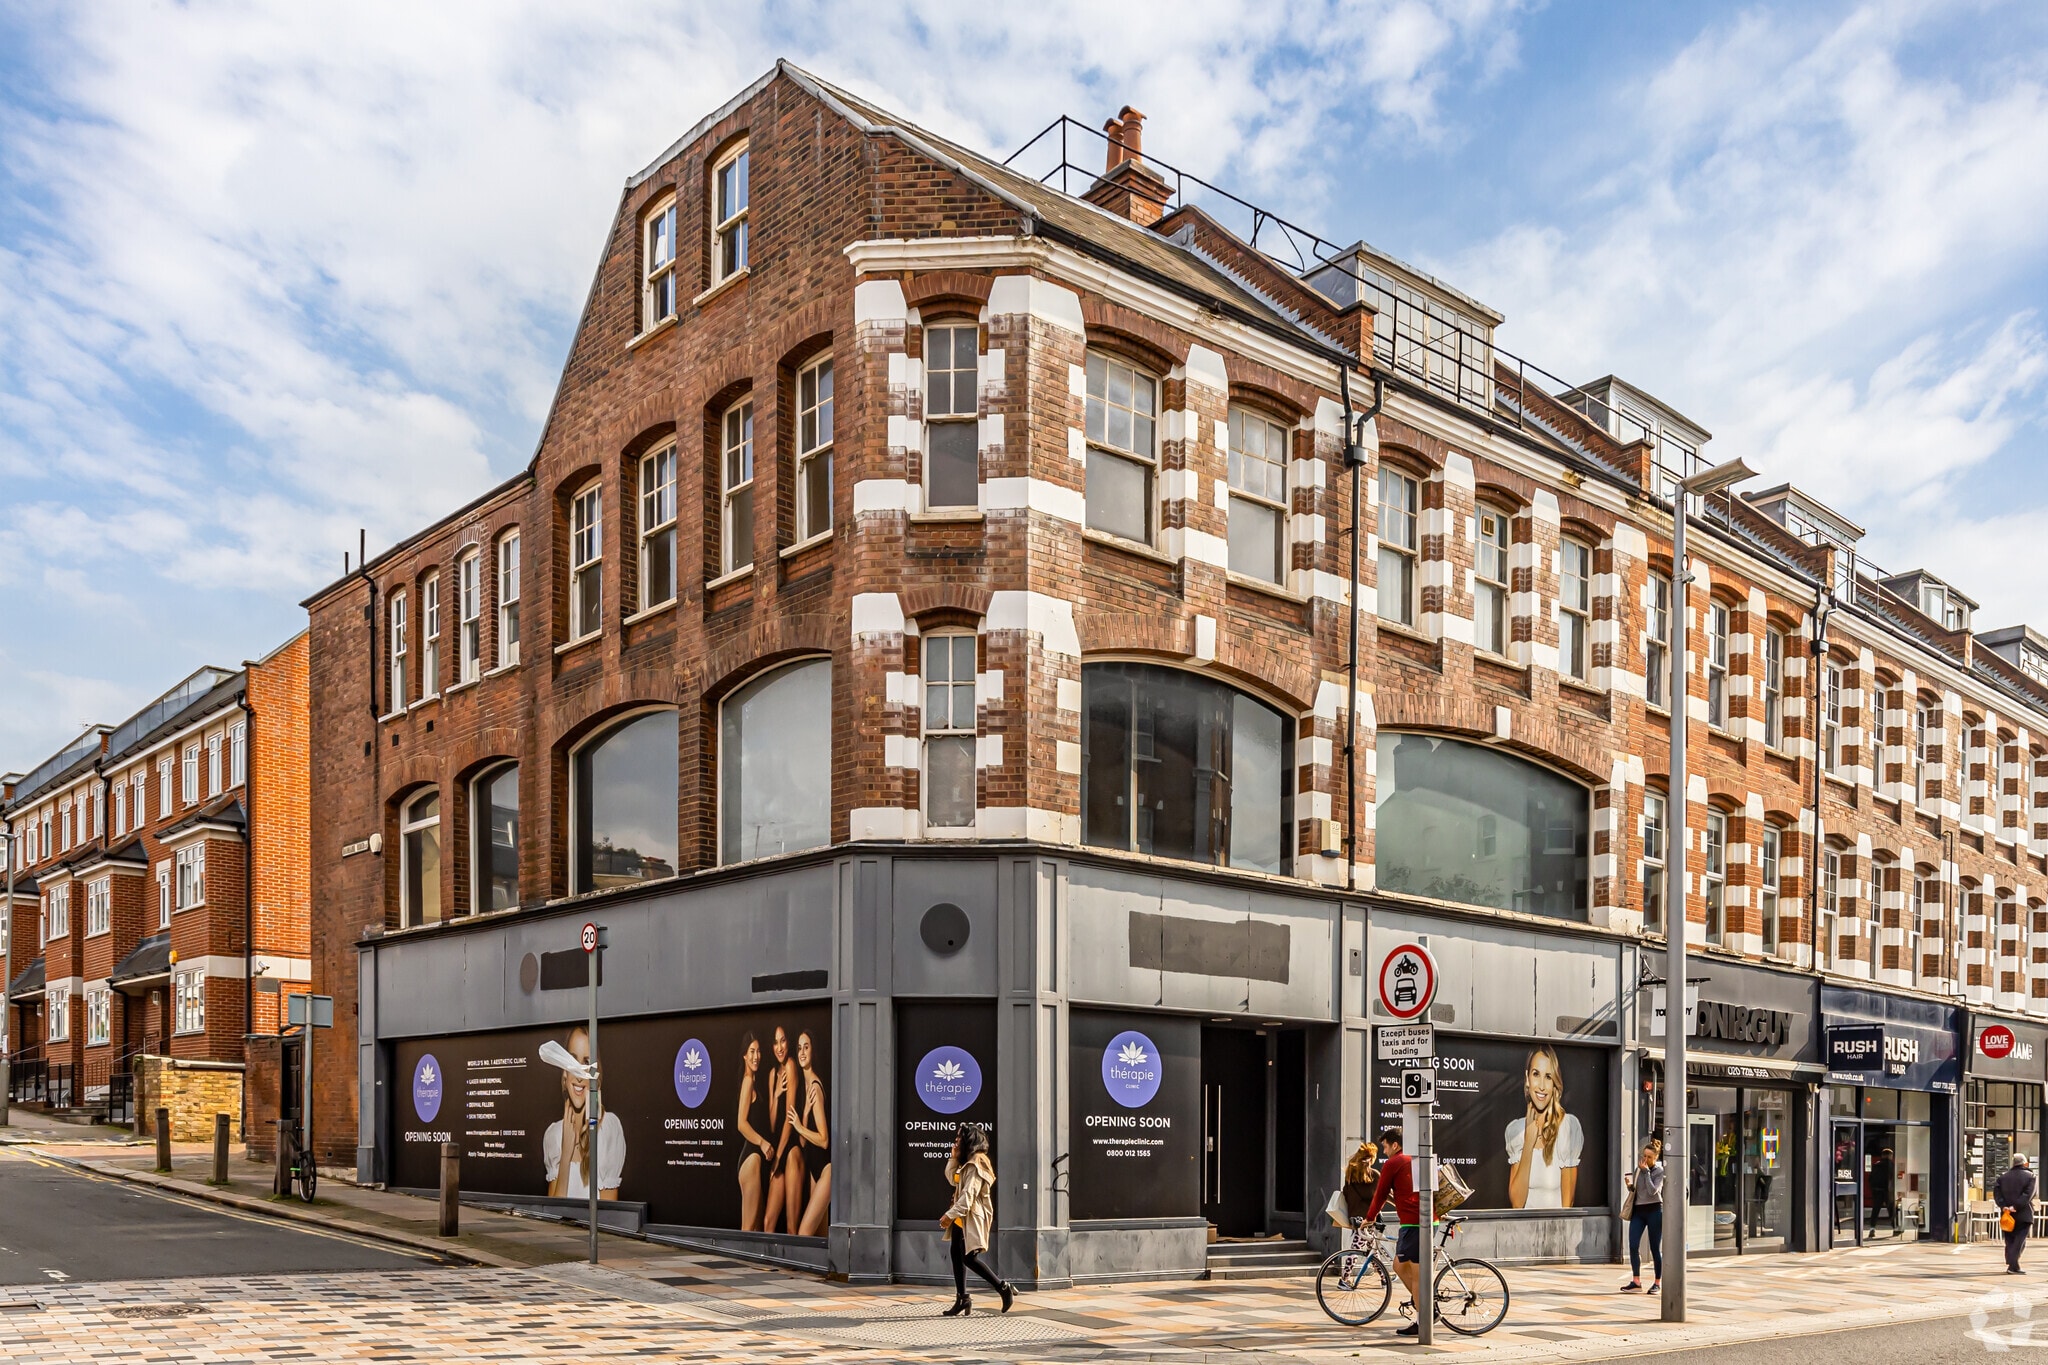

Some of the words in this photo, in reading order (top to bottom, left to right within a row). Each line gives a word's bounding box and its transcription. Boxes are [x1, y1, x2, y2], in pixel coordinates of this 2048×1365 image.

[584, 932, 594, 943] 20
[1697, 1001, 1794, 1045] ONI&GUY
[1985, 1035, 2008, 1044] LOVE
[1834, 1040, 1877, 1054] RUSH
[1884, 1036, 1918, 1062] RUSH
[1443, 1058, 1475, 1070] SOON
[1892, 1064, 1906, 1074] HAIR
[680, 1070, 706, 1086] thérapie
[1110, 1065, 1154, 1083] thérapie
[925, 1080, 972, 1096] thérapie
[664, 1118, 699, 1129] OPENING
[700, 1118, 724, 1130] SOON
[905, 1122, 957, 1131] OPENING
[1085, 1115, 1136, 1127] OPENING
[1139, 1117, 1171, 1128] SOON
[404, 1132, 431, 1142] OPENING
[433, 1132, 451, 1142] SOON
